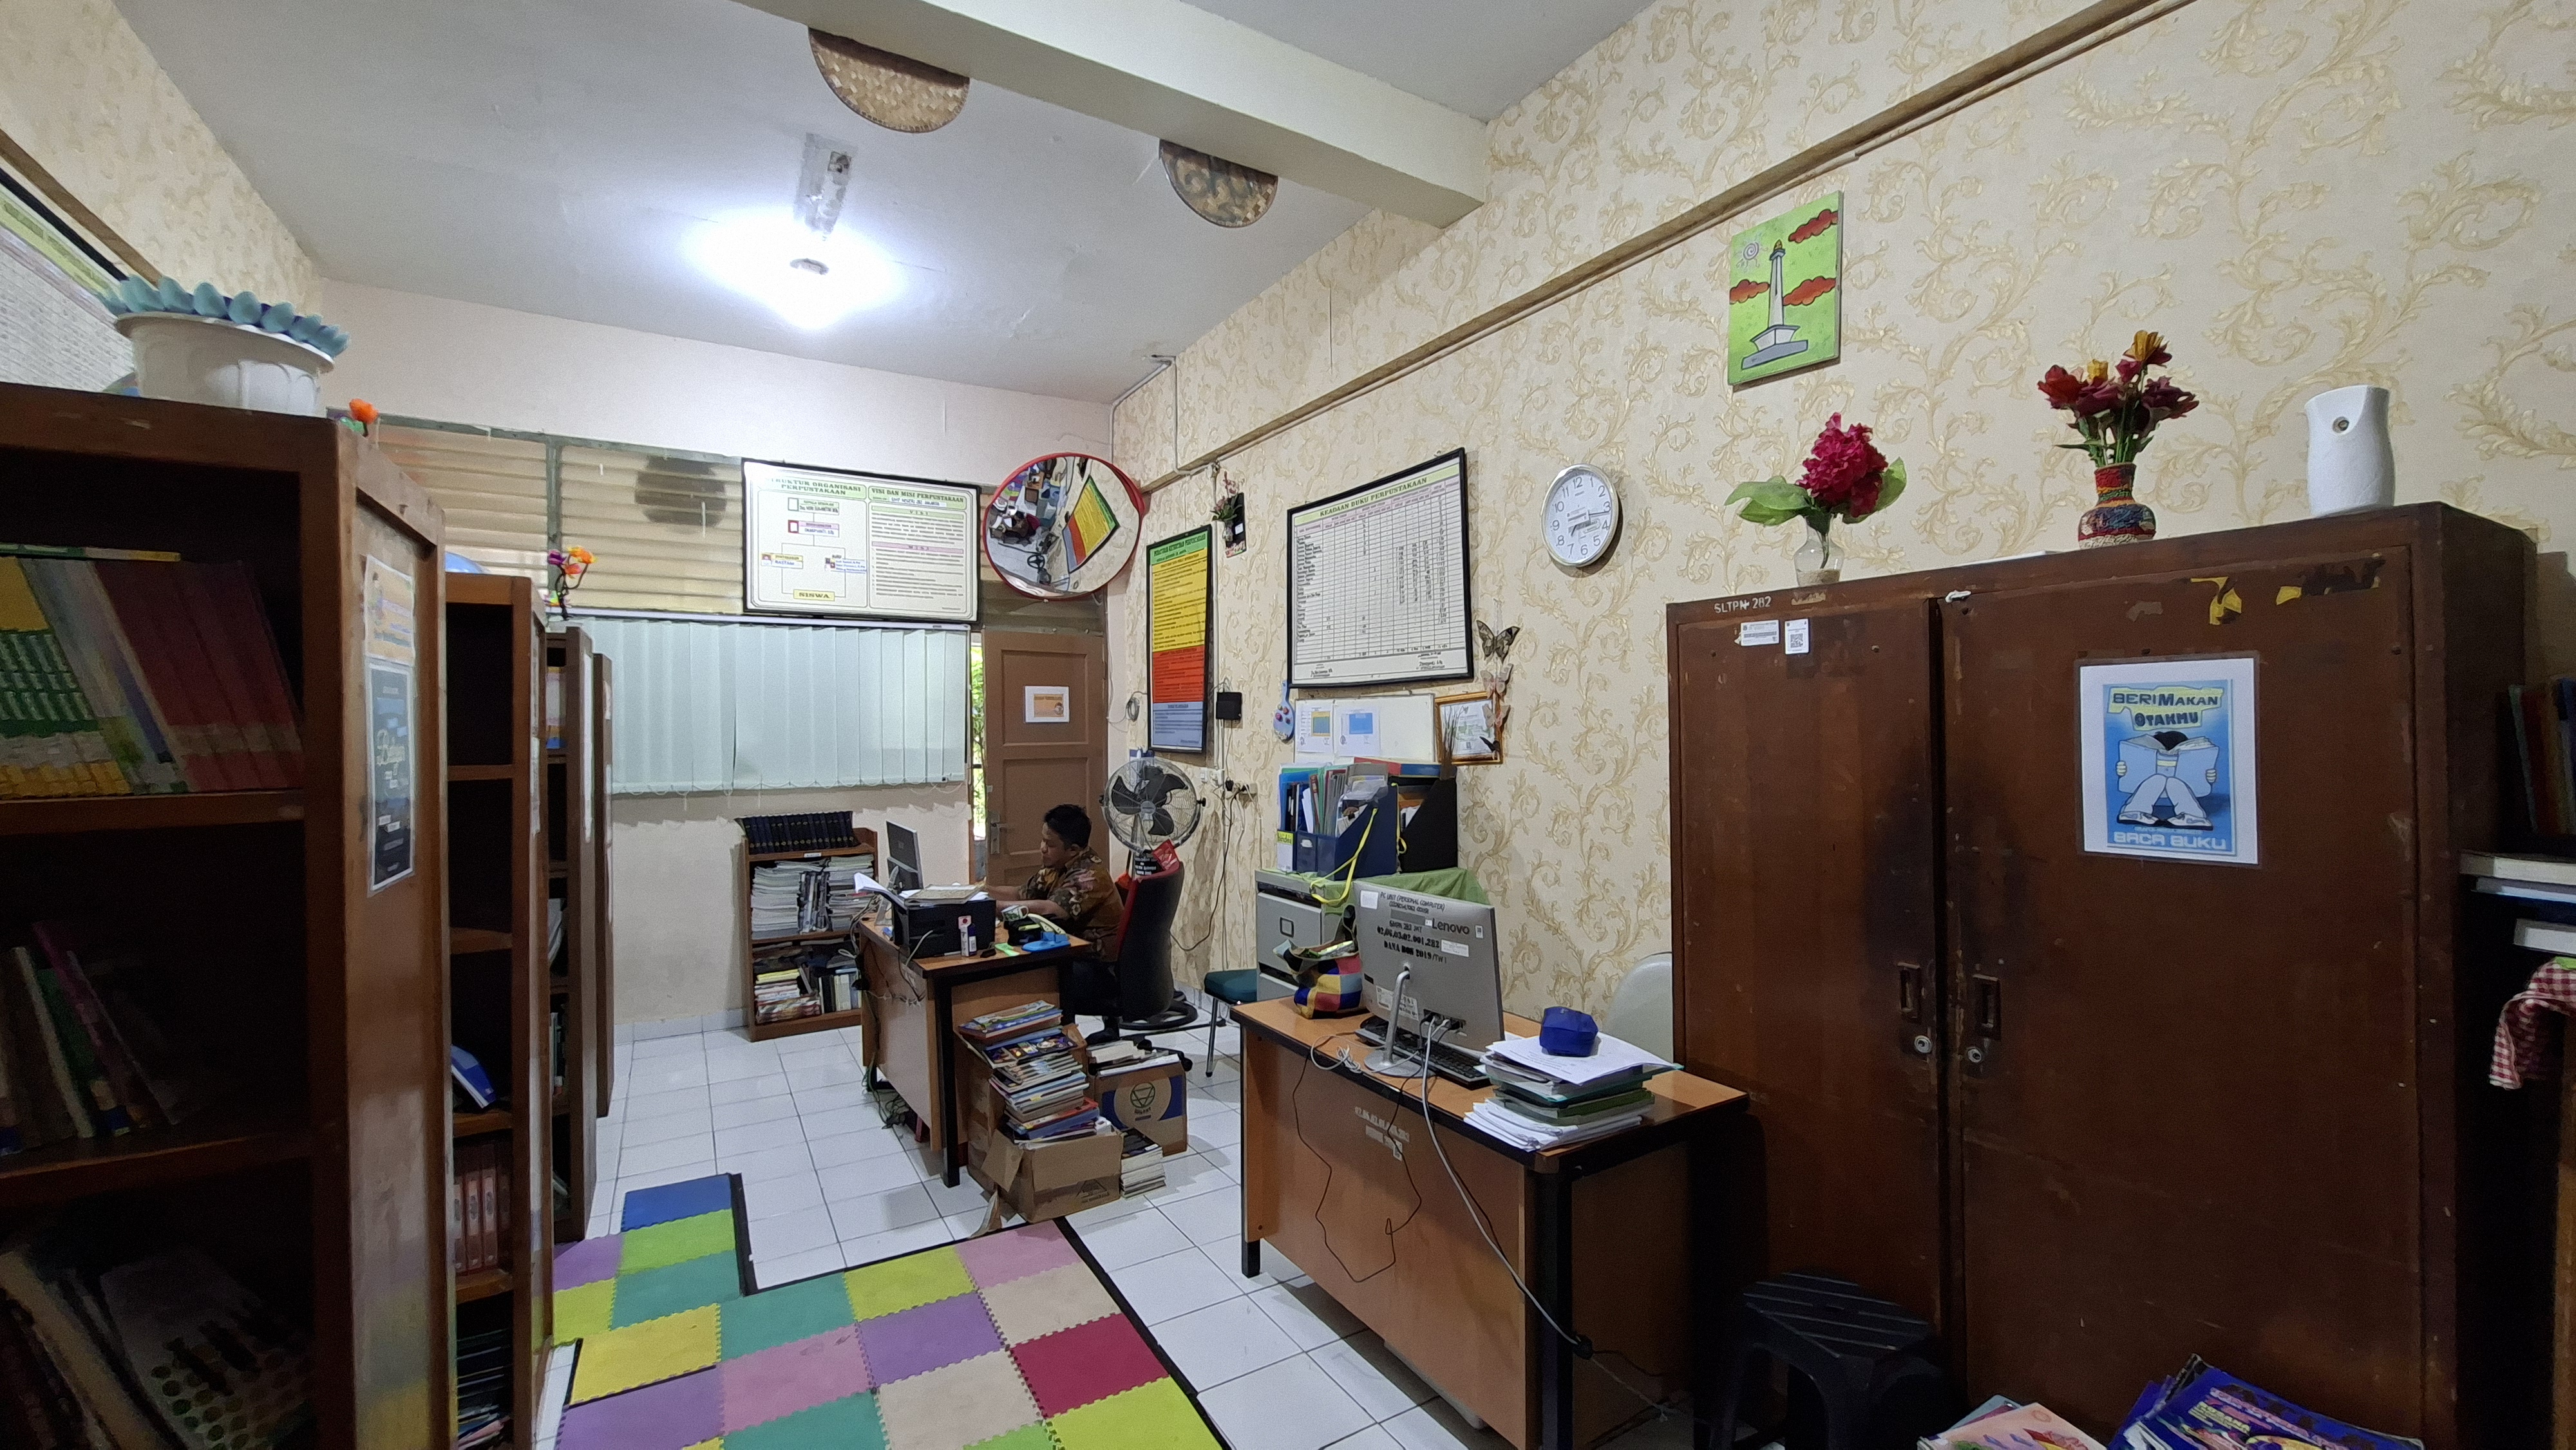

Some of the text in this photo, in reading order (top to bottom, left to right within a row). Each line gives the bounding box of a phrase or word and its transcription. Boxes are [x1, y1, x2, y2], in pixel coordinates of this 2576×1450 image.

[812, 482, 861, 492] ORGANISASI
[1573, 477, 1583, 489] 12
[1589, 476, 1594, 487] 1
[781, 484, 846, 495] PERPUSTAKAAN
[1562, 485, 1569, 498] 11
[1598, 485, 1605, 497] 2
[917, 493, 964, 503] PERPUSTAKAAN
[1320, 503, 1350, 517] KEADAAN
[1350, 496, 1369, 507] BUKU
[1370, 477, 1427, 501] PERPUSTAKAAN
[1554, 501, 1564, 513] 10
[1604, 502, 1611, 513] 3
[1552, 520, 1560, 531] 9
[1602, 520, 1609, 531] 4
[1557, 535, 1564, 546] 8
[1593, 535, 1601, 546] 5
[1567, 543, 1575, 555] 7
[1580, 544, 1588, 555] 6
[1752, 596, 1772, 608] 282
[2134, 711, 2199, 727] OTAKMU
[2113, 831, 2226, 850] BACA BUKU
[1432, 918, 1470, 935] Lenovo
